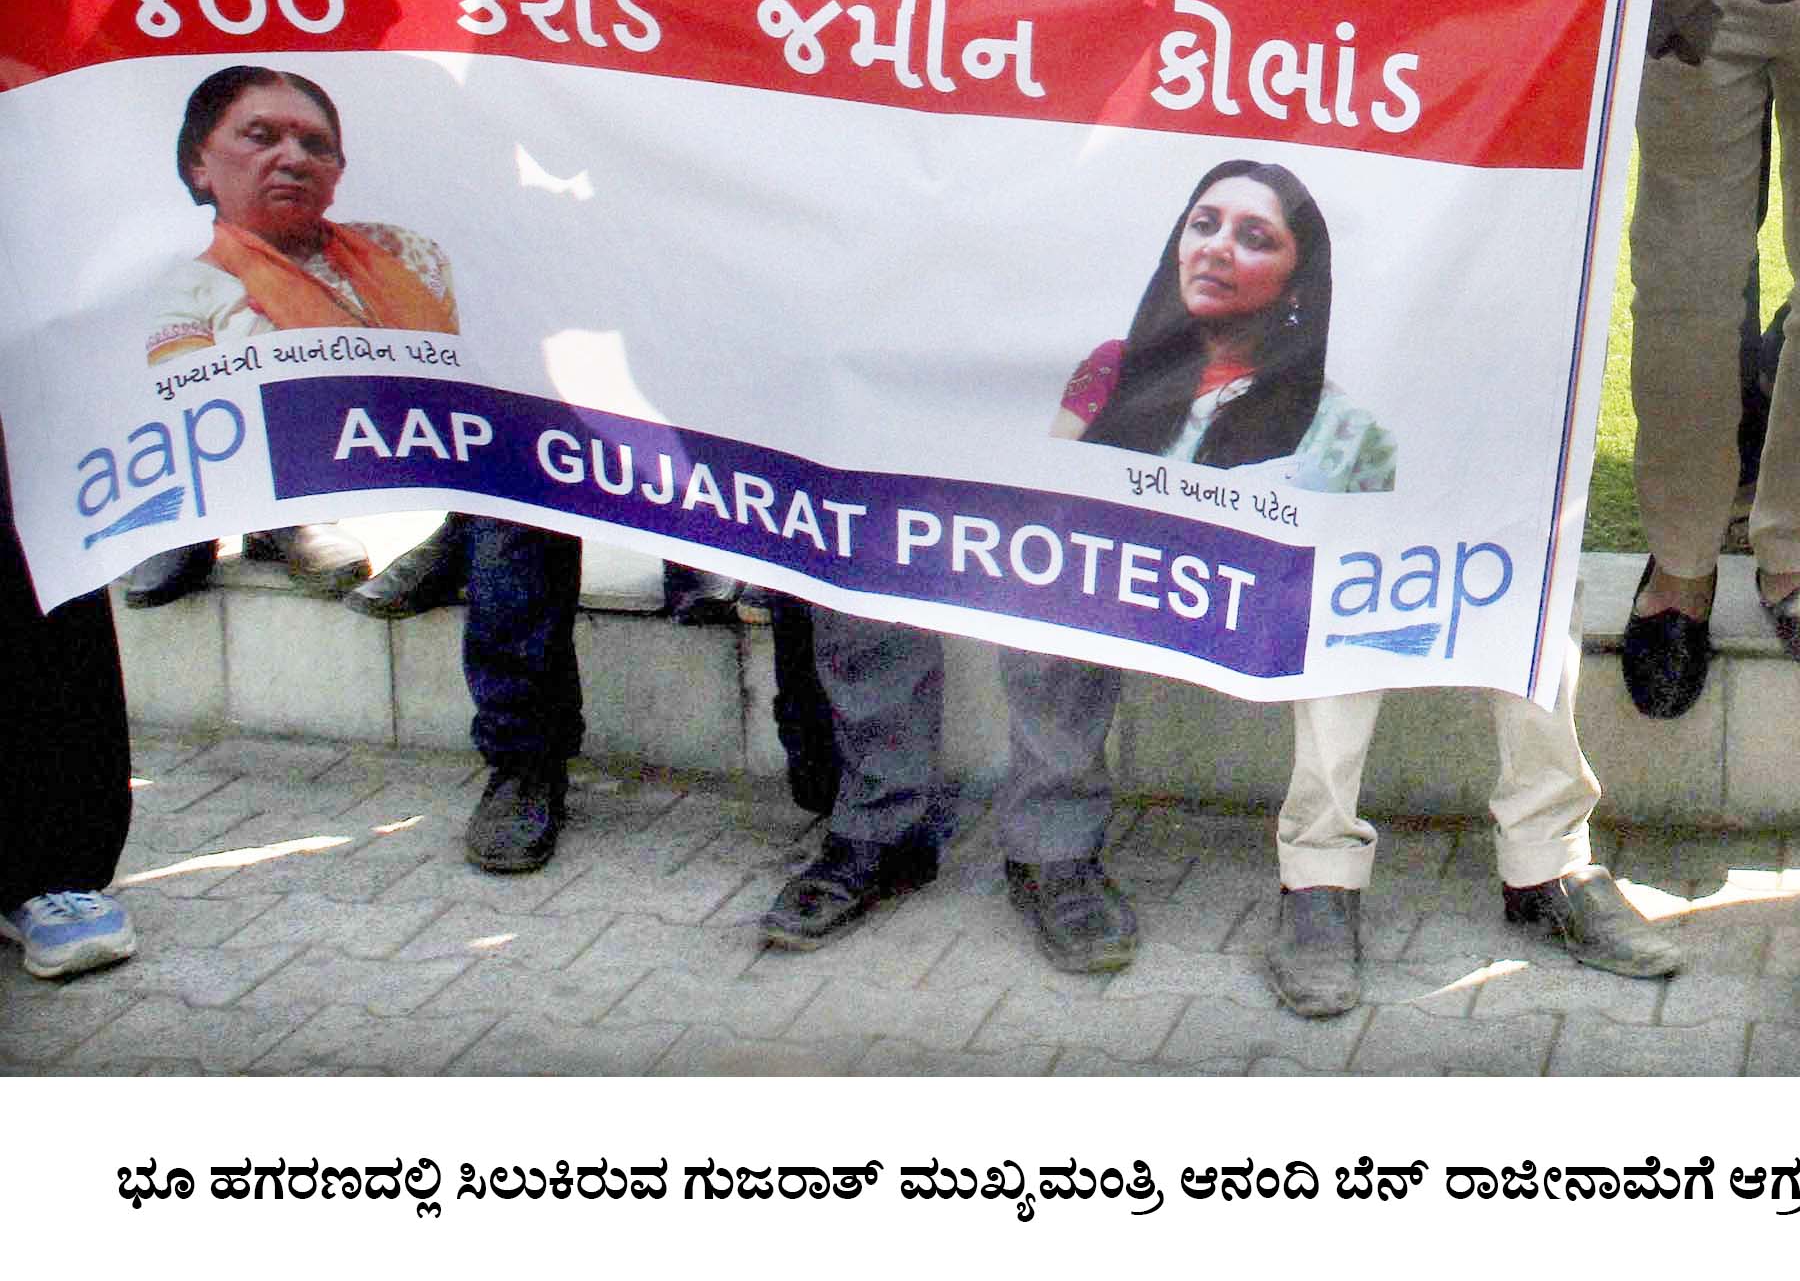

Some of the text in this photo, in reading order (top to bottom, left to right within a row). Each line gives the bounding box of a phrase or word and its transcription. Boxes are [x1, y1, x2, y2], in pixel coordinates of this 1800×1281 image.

[273, 337, 398, 367] આનંદીબેન
[405, 339, 462, 370] પટેલ
[76, 397, 1515, 660] aap AAP GUJARAT PROTEST aap
[1179, 474, 1241, 512] અનાર
[1251, 491, 1300, 529] પટેલ
